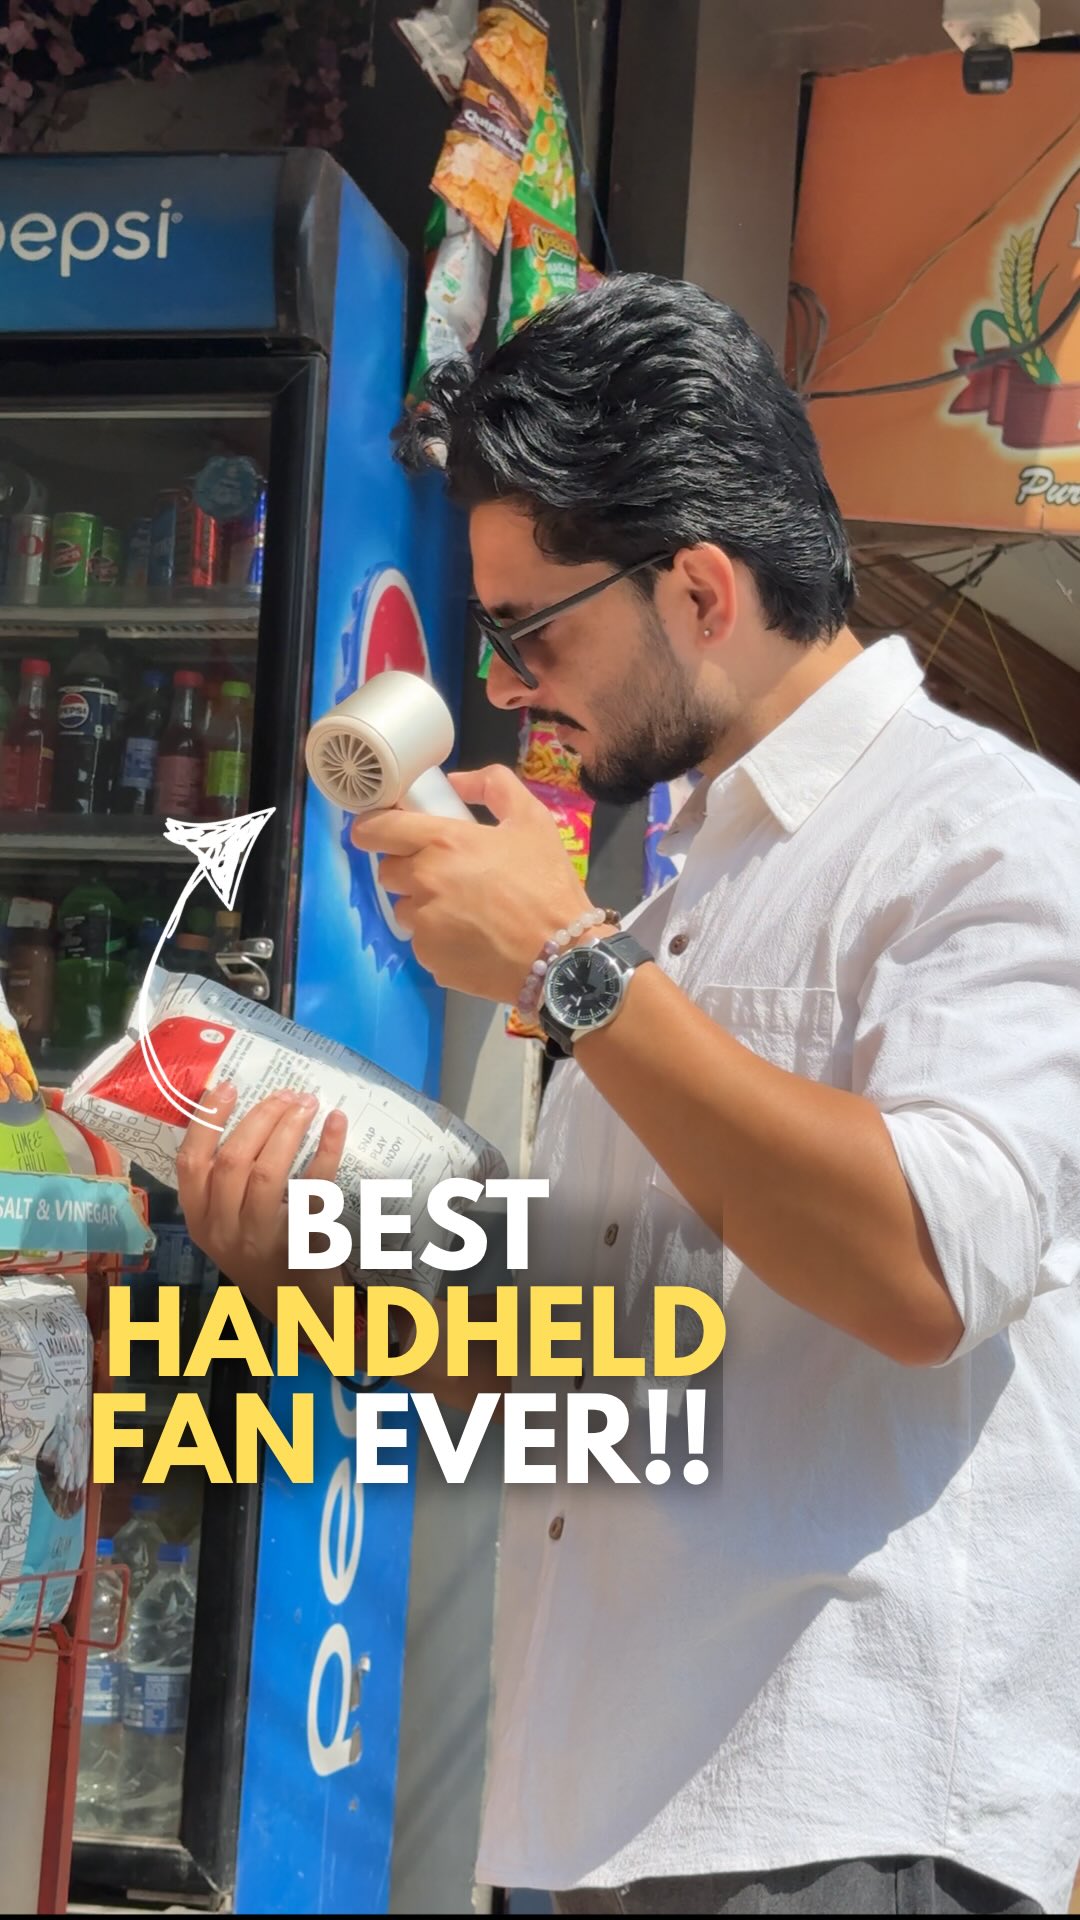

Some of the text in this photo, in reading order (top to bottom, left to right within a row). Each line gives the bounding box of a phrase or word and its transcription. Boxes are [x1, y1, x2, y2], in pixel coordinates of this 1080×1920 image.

[0, 198, 173, 278] epsi
[358, 1126, 376, 1153] SNAP
[370, 1136, 388, 1160] PLAY
[36, 1199, 50, 1221] &
[55, 1199, 119, 1226] VINEGAR
